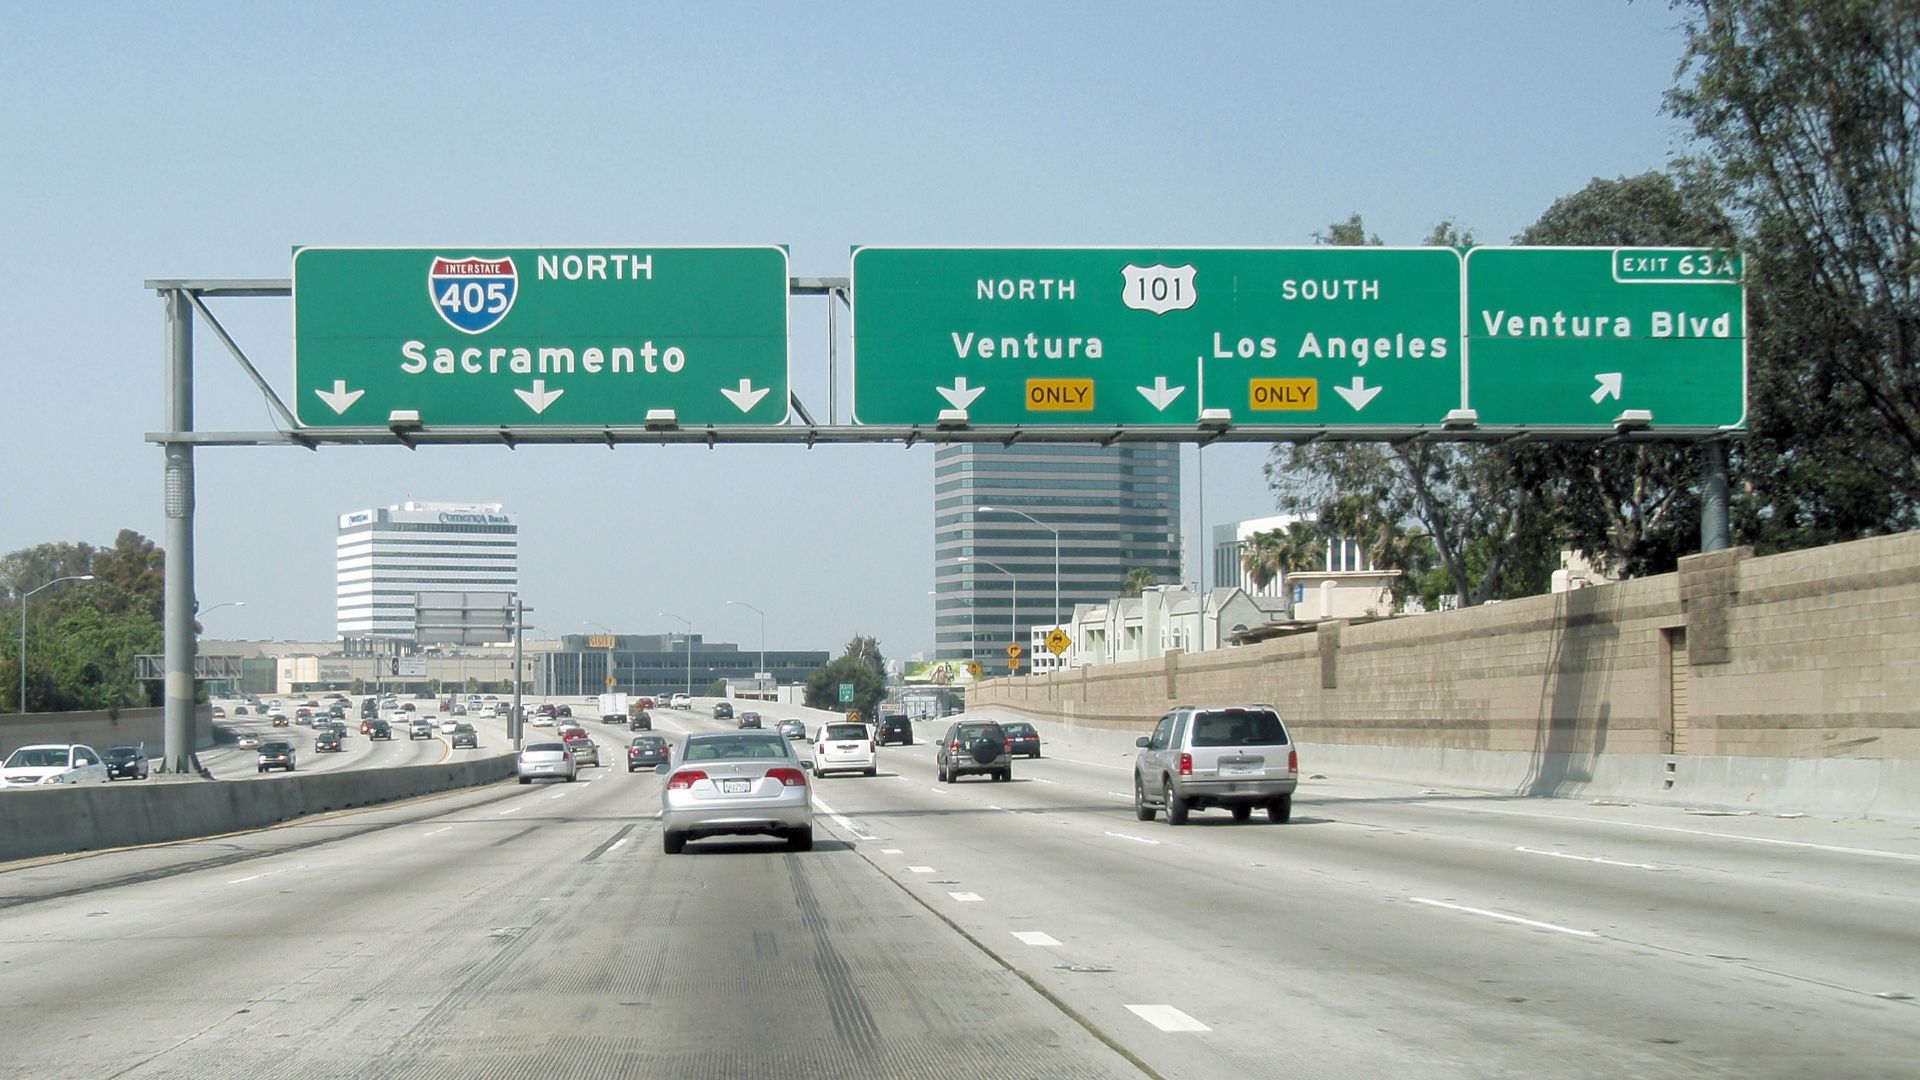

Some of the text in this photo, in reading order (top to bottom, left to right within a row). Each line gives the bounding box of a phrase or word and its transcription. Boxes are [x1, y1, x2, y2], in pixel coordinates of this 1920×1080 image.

[444, 263, 502, 275] INTERSTATE
[538, 255, 653, 280] NORTH
[1623, 255, 1735, 276] EXIT 63A
[440, 283, 509, 314] 405
[977, 279, 1075, 300] NORTH
[1137, 277, 1182, 302] 101
[1282, 279, 1379, 300] SOUTH
[1482, 311, 1730, 338] Ventura Blvd
[401, 340, 686, 374] Sacramento
[951, 333, 1102, 359] Ventura
[1214, 332, 1447, 367] Los Angeles
[1031, 386, 1088, 403] ONLY
[1254, 386, 1312, 403] ONLY
